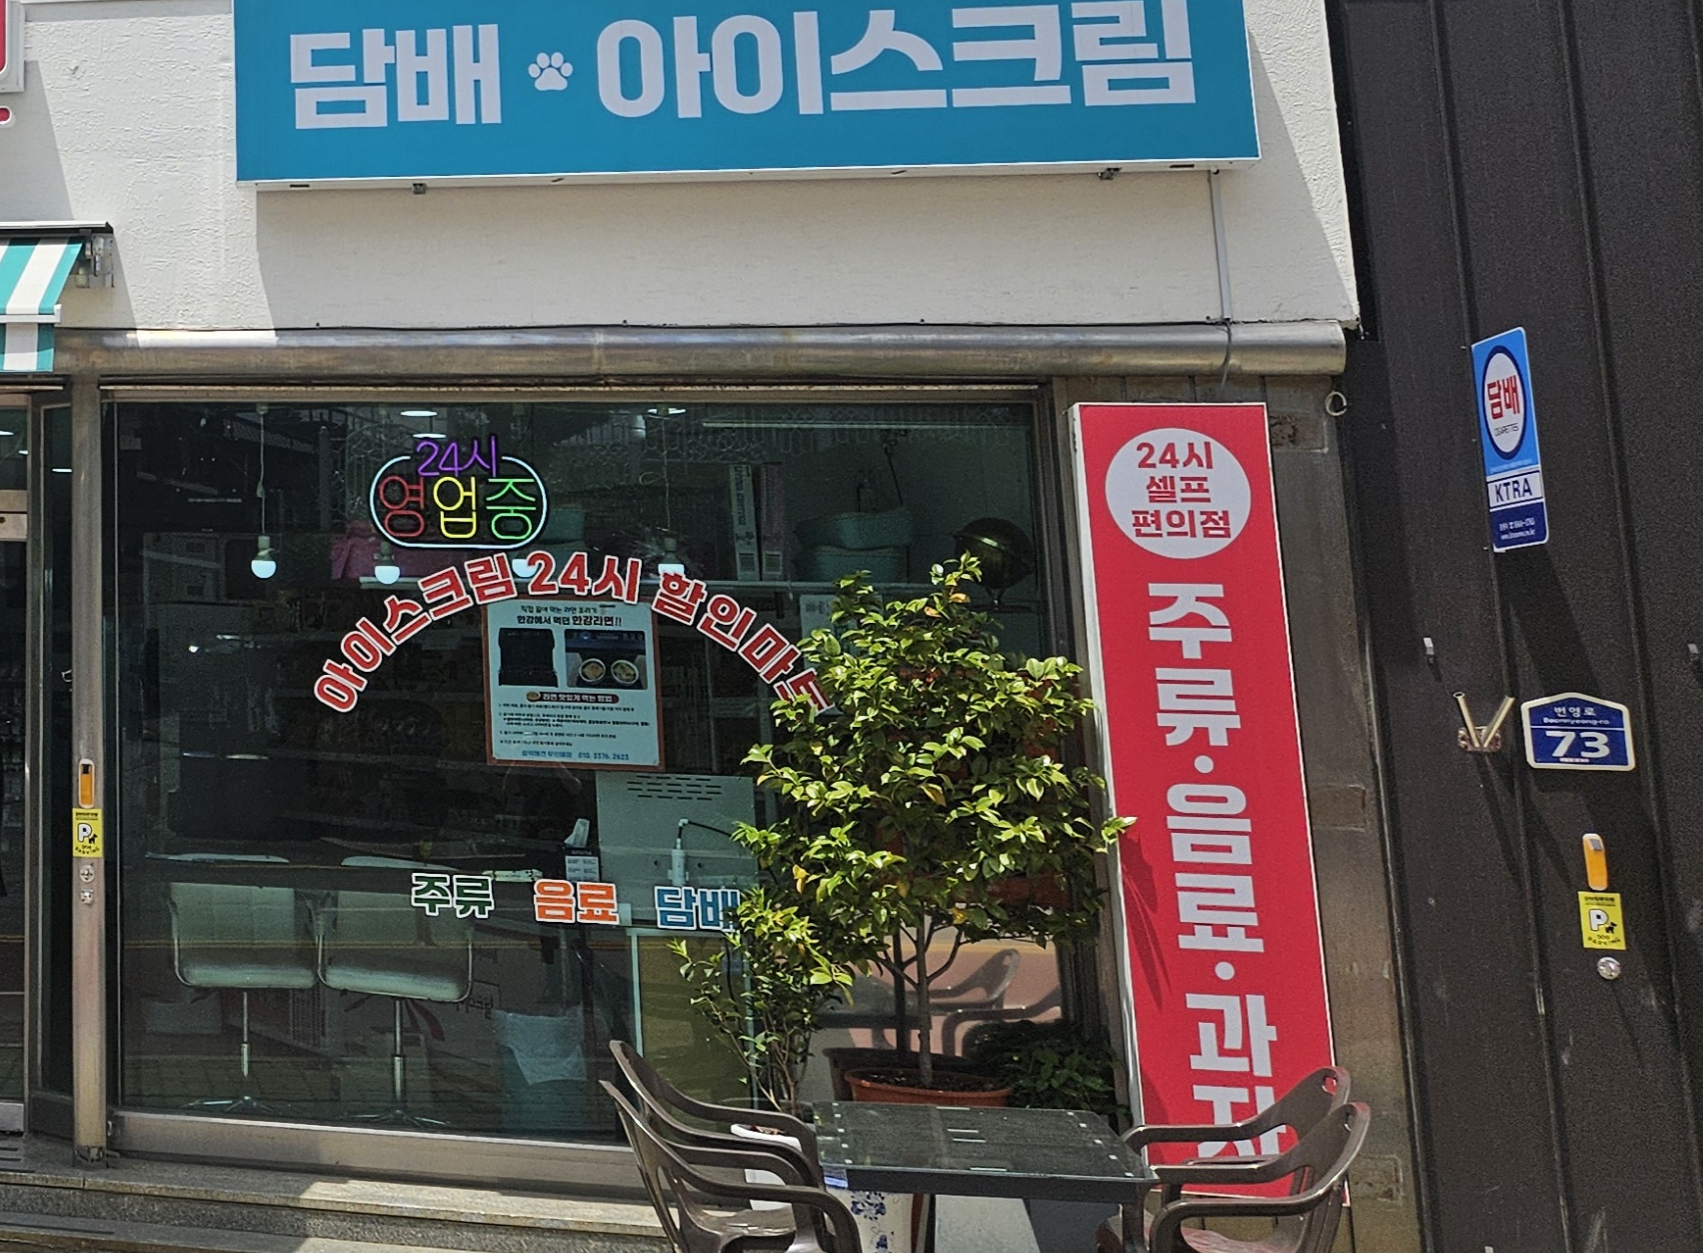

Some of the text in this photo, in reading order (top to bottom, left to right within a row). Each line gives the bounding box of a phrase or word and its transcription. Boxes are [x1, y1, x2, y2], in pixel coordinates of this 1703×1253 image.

[289, 22, 503, 130] 담배
[1486, 375, 1521, 420] 담배
[415, 435, 497, 478] 24시
[1136, 441, 1214, 469] 24시
[1146, 475, 1212, 504] 셀프
[1494, 477, 1533, 503] KTRA
[379, 475, 537, 540] 영업중
[1131, 510, 1232, 539] 편의점
[313, 550, 836, 716] 아이스크림 24시 할인마트
[516, 615, 552, 626] 한강에서
[1553, 707, 1597, 718] 번영로
[1545, 730, 1611, 759] 73
[77, 822, 93, 843] P
[411, 873, 741, 933] 주류 음료 담배
[1588, 908, 1610, 932] P
